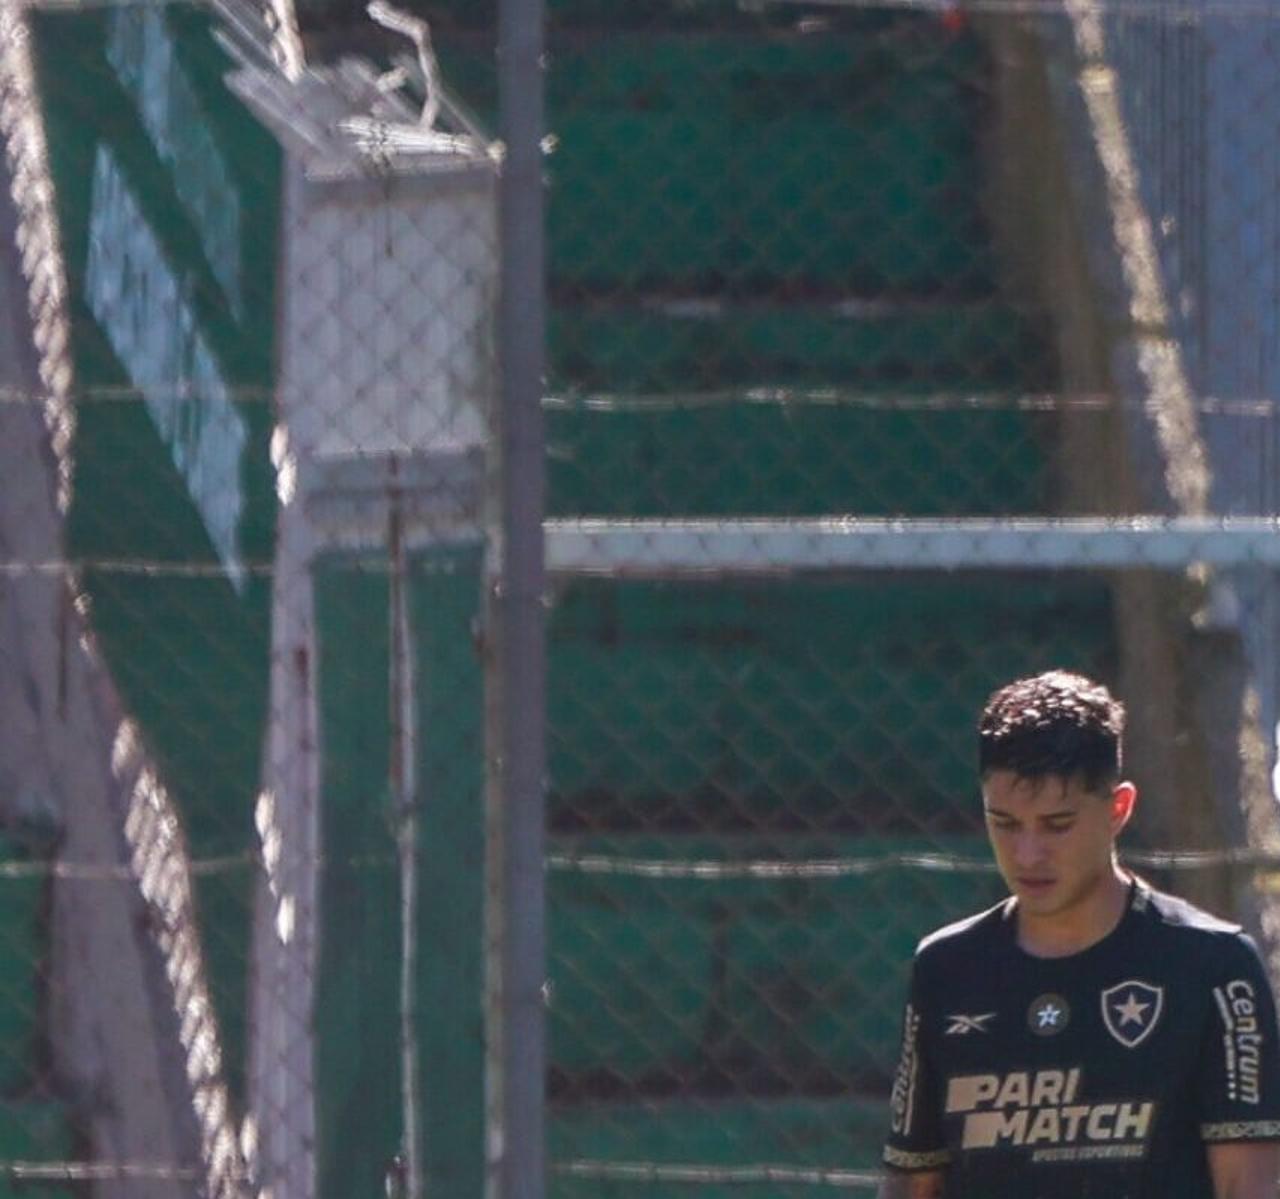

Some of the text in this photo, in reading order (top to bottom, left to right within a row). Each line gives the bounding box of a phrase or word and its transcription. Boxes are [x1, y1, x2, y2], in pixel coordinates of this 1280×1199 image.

[1226, 980, 1260, 1104] Centrum
[947, 1068, 1080, 1113] PARI
[962, 1103, 1152, 1149] MATCH
